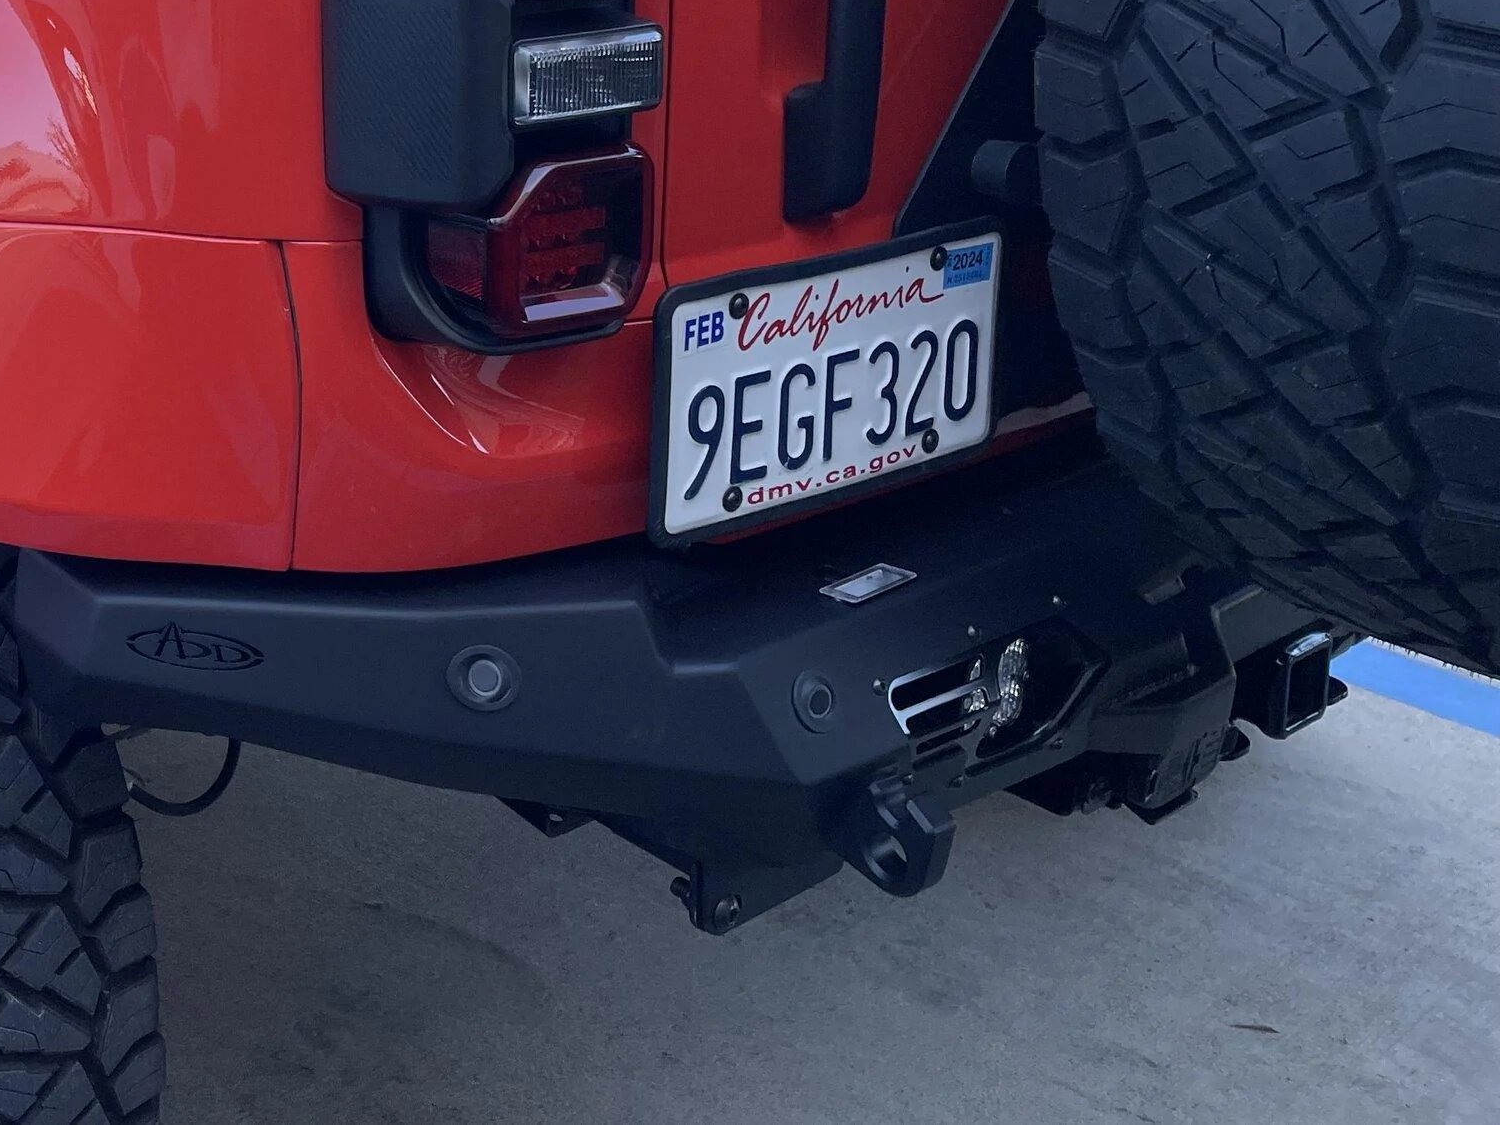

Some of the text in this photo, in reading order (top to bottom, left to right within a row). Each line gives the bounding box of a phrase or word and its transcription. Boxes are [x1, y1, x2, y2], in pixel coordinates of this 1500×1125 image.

[953, 250, 983, 271] 2024
[684, 310, 725, 352] FEB
[737, 266, 945, 352] California
[683, 318, 980, 501] 9EGF320
[747, 444, 917, 505] dmv.ca.gov
